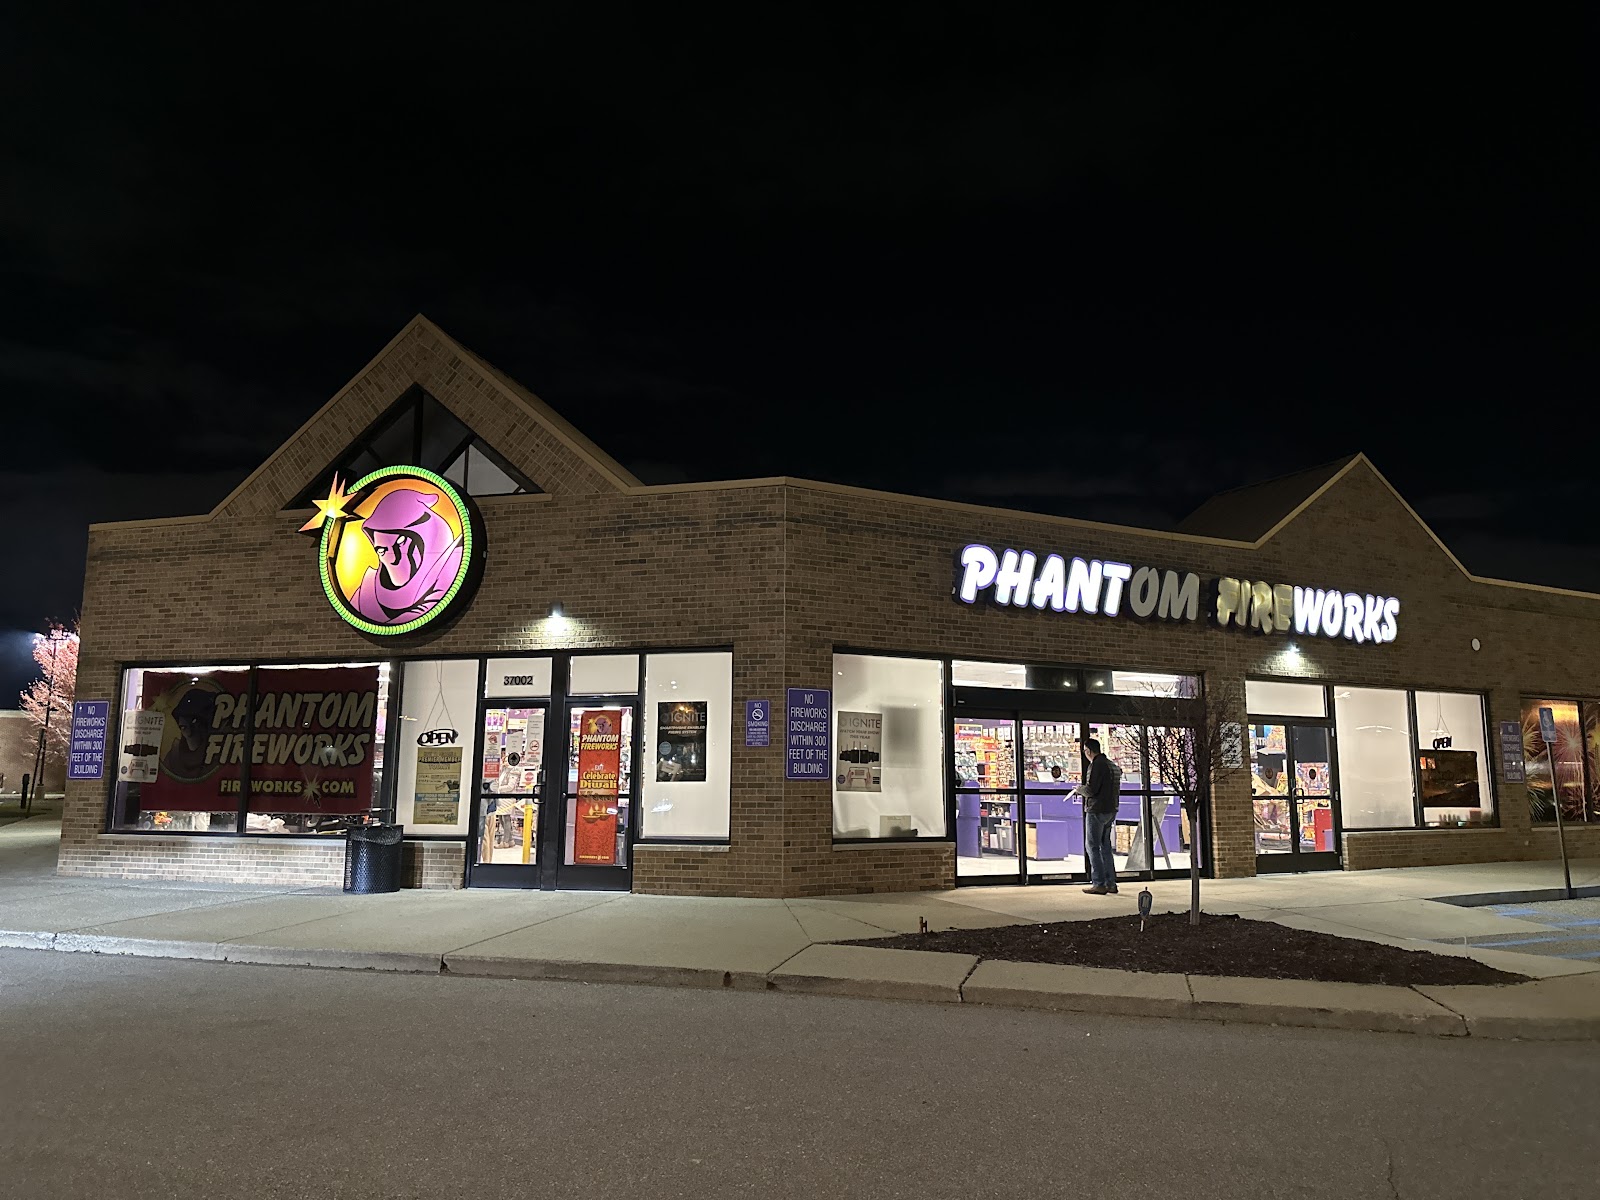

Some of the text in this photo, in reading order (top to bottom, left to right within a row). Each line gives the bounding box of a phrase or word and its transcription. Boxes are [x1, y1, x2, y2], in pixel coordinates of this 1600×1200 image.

[959, 543, 1400, 645] PHANTOM FIREWORKS
[504, 675, 533, 686] 37002
[804, 694, 814, 705] NO
[87, 705, 96, 715] NO
[211, 691, 376, 729] PHANTOM
[790, 707, 827, 719] FIREWORKS
[75, 717, 105, 727] FIREWORKS
[134, 715, 164, 726] IGNITE
[671, 711, 706, 722] IGNITE
[790, 721, 827, 732] DISCHARGE
[849, 717, 881, 729] IGNITE
[74, 728, 104, 738] DISCHARGE
[420, 731, 456, 744] OPEN
[581, 734, 620, 743] PHANTOM
[74, 740, 103, 750] WITHIN 300
[790, 735, 827, 746] WITHIN 300
[204, 733, 371, 767] FIREWORKS
[580, 742, 619, 751] FIREWORKS
[72, 752, 103, 762] FEET OF THE
[789, 749, 827, 760] FEET OF THE
[73, 764, 98, 774] BUILDING
[793, 763, 823, 774] BUILDING
[582, 771, 616, 780] Celebrate
[220, 779, 302, 793] FIRWORKS
[580, 779, 618, 789] Diwali
